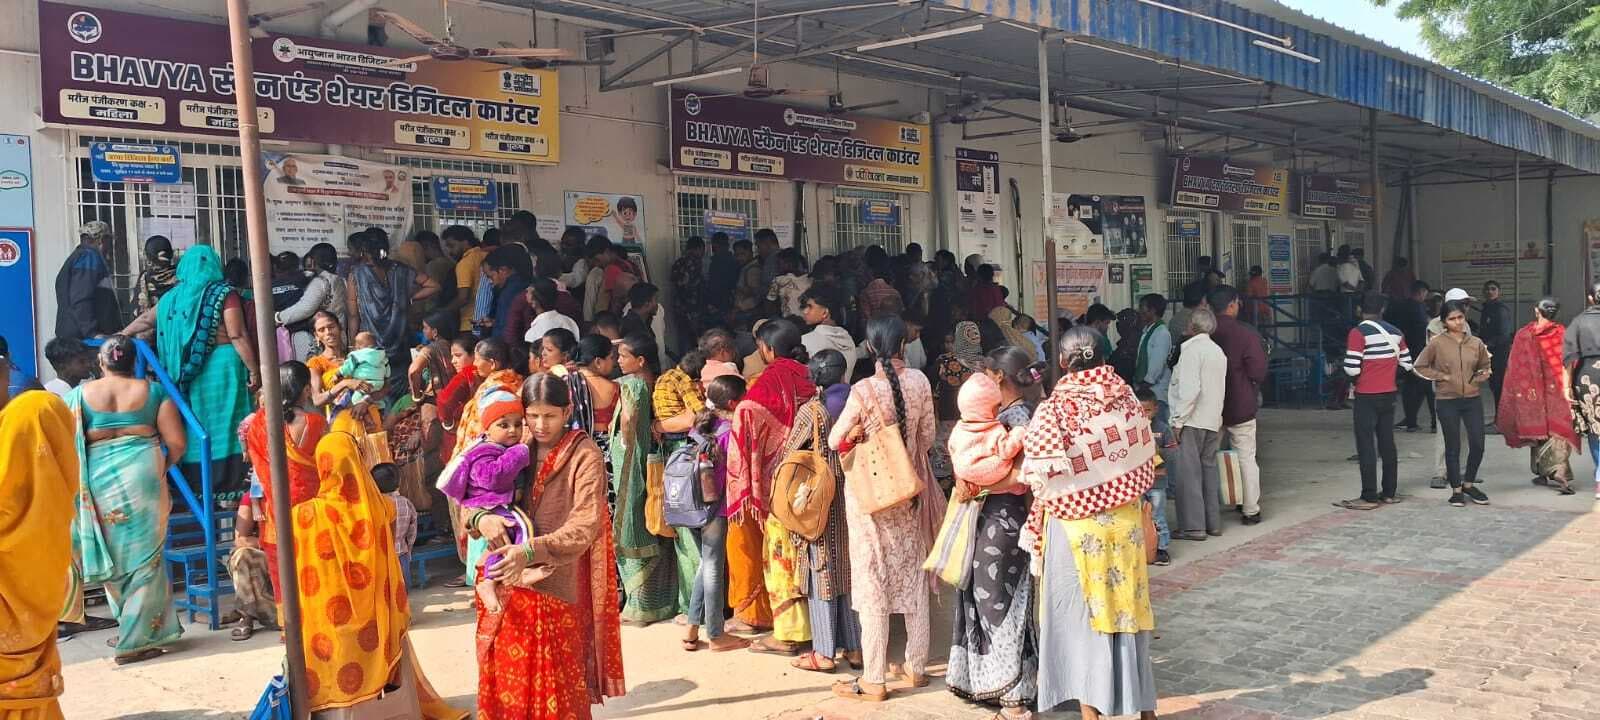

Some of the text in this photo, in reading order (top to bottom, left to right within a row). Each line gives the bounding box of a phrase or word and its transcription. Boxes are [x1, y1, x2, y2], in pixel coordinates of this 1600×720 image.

[71, 51, 206, 92] BHAVYA
[285, 71, 321, 104] एंड
[325, 75, 385, 110] शेयर
[387, 81, 473, 119] डिजिटल
[475, 97, 541, 126] काउंटर
[67, 93, 89, 104] मरीज
[91, 94, 128, 109] पंजीकरण
[130, 98, 147, 109] कक्ष
[95, 109, 133, 120] महिला
[186, 104, 205, 115] मरीज
[686, 120, 921, 166] BHAVYA स्कैन एंड शेयर डिजिटल काउंटर
